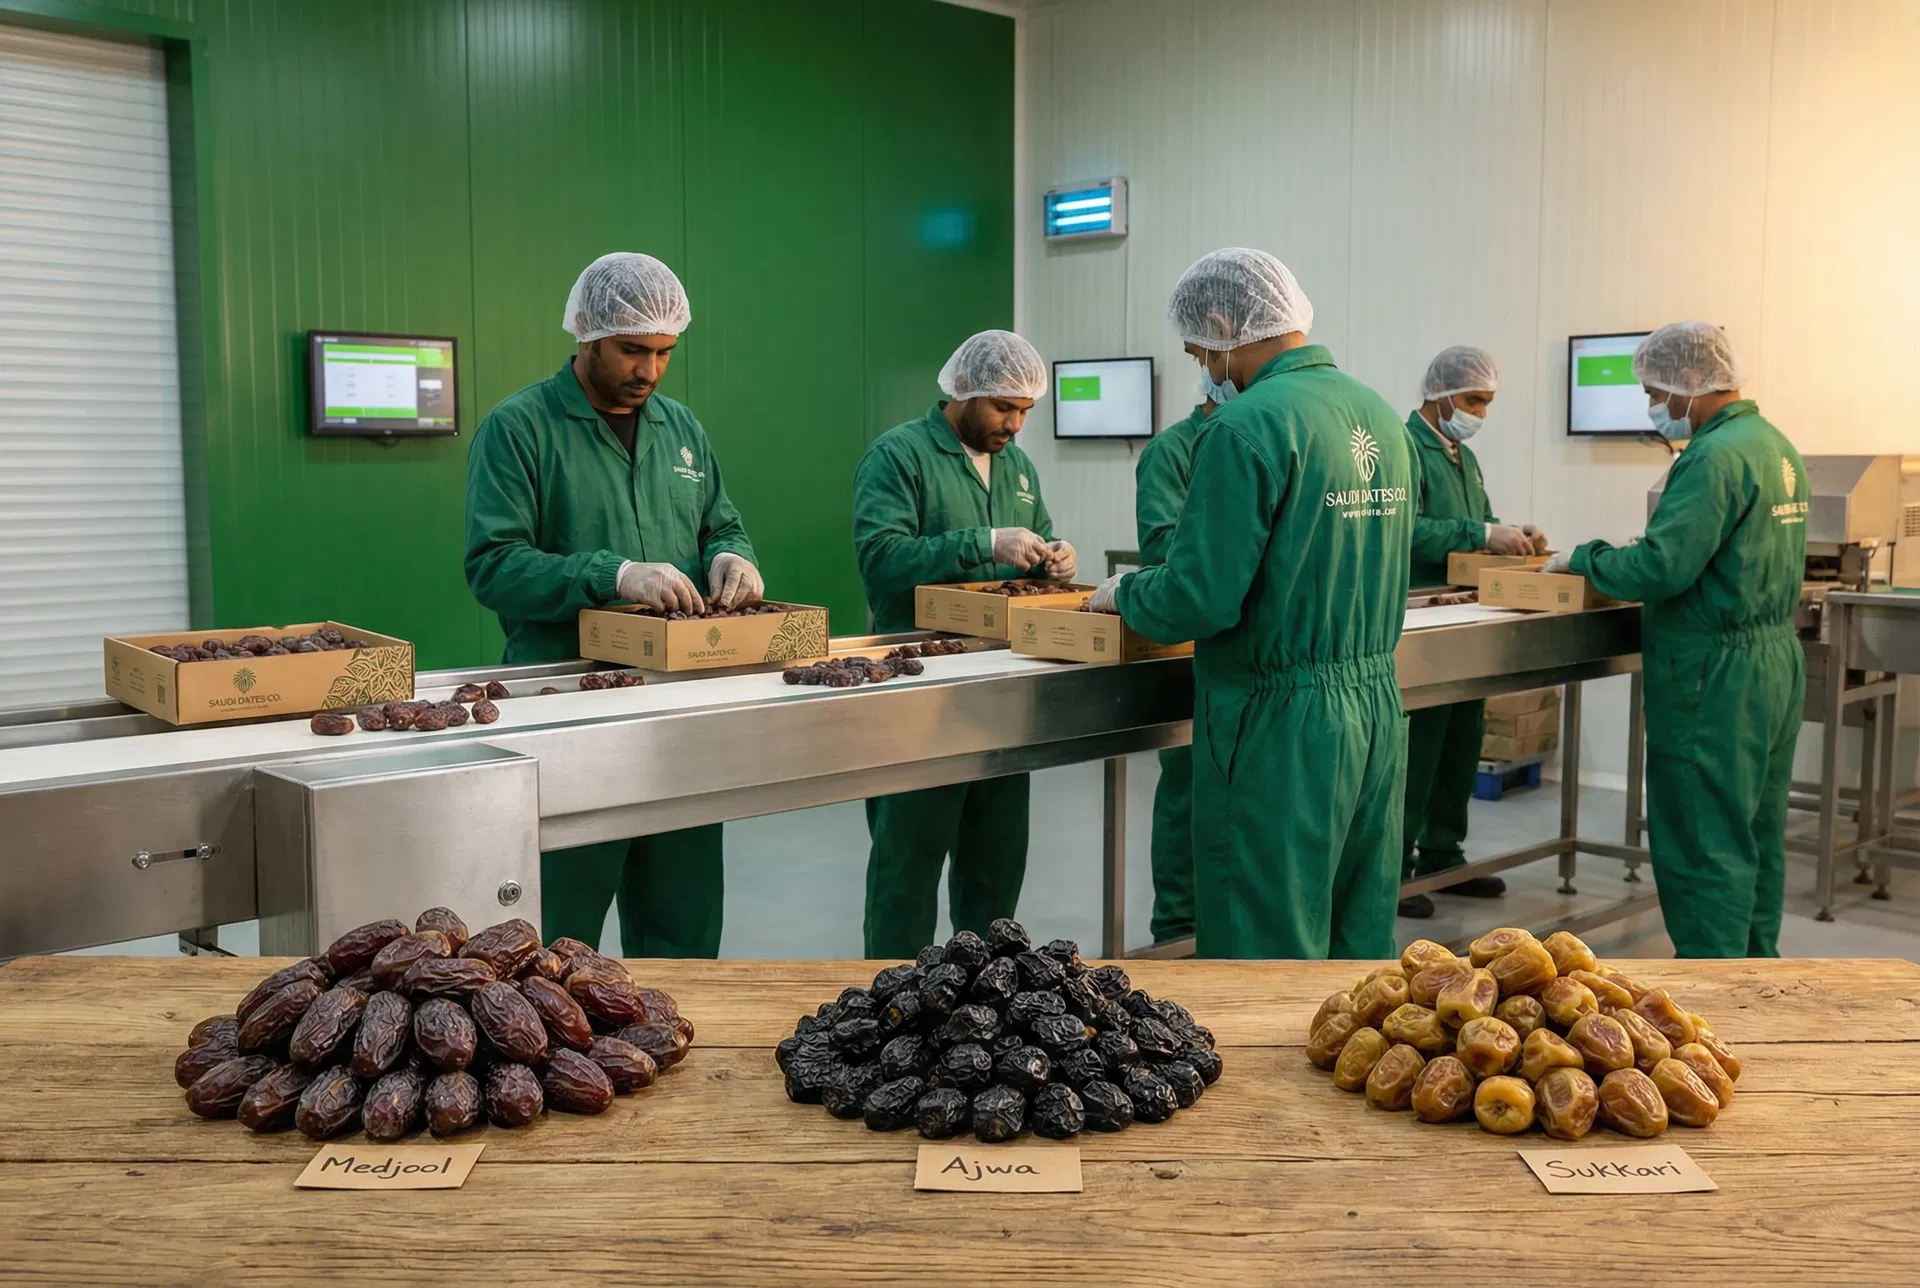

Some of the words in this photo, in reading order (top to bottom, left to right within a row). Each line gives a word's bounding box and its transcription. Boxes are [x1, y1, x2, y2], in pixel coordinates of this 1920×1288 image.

[1325, 490, 1360, 507] SAUDI
[1361, 488, 1394, 503] DATES
[208, 697, 237, 708] SAUDI
[238, 694, 266, 705] DATES
[267, 693, 283, 702] CO.
[320, 1156, 452, 1179] Medjool
[940, 1156, 1040, 1181] Ajwa
[1545, 1160, 1681, 1179] Sukkari
